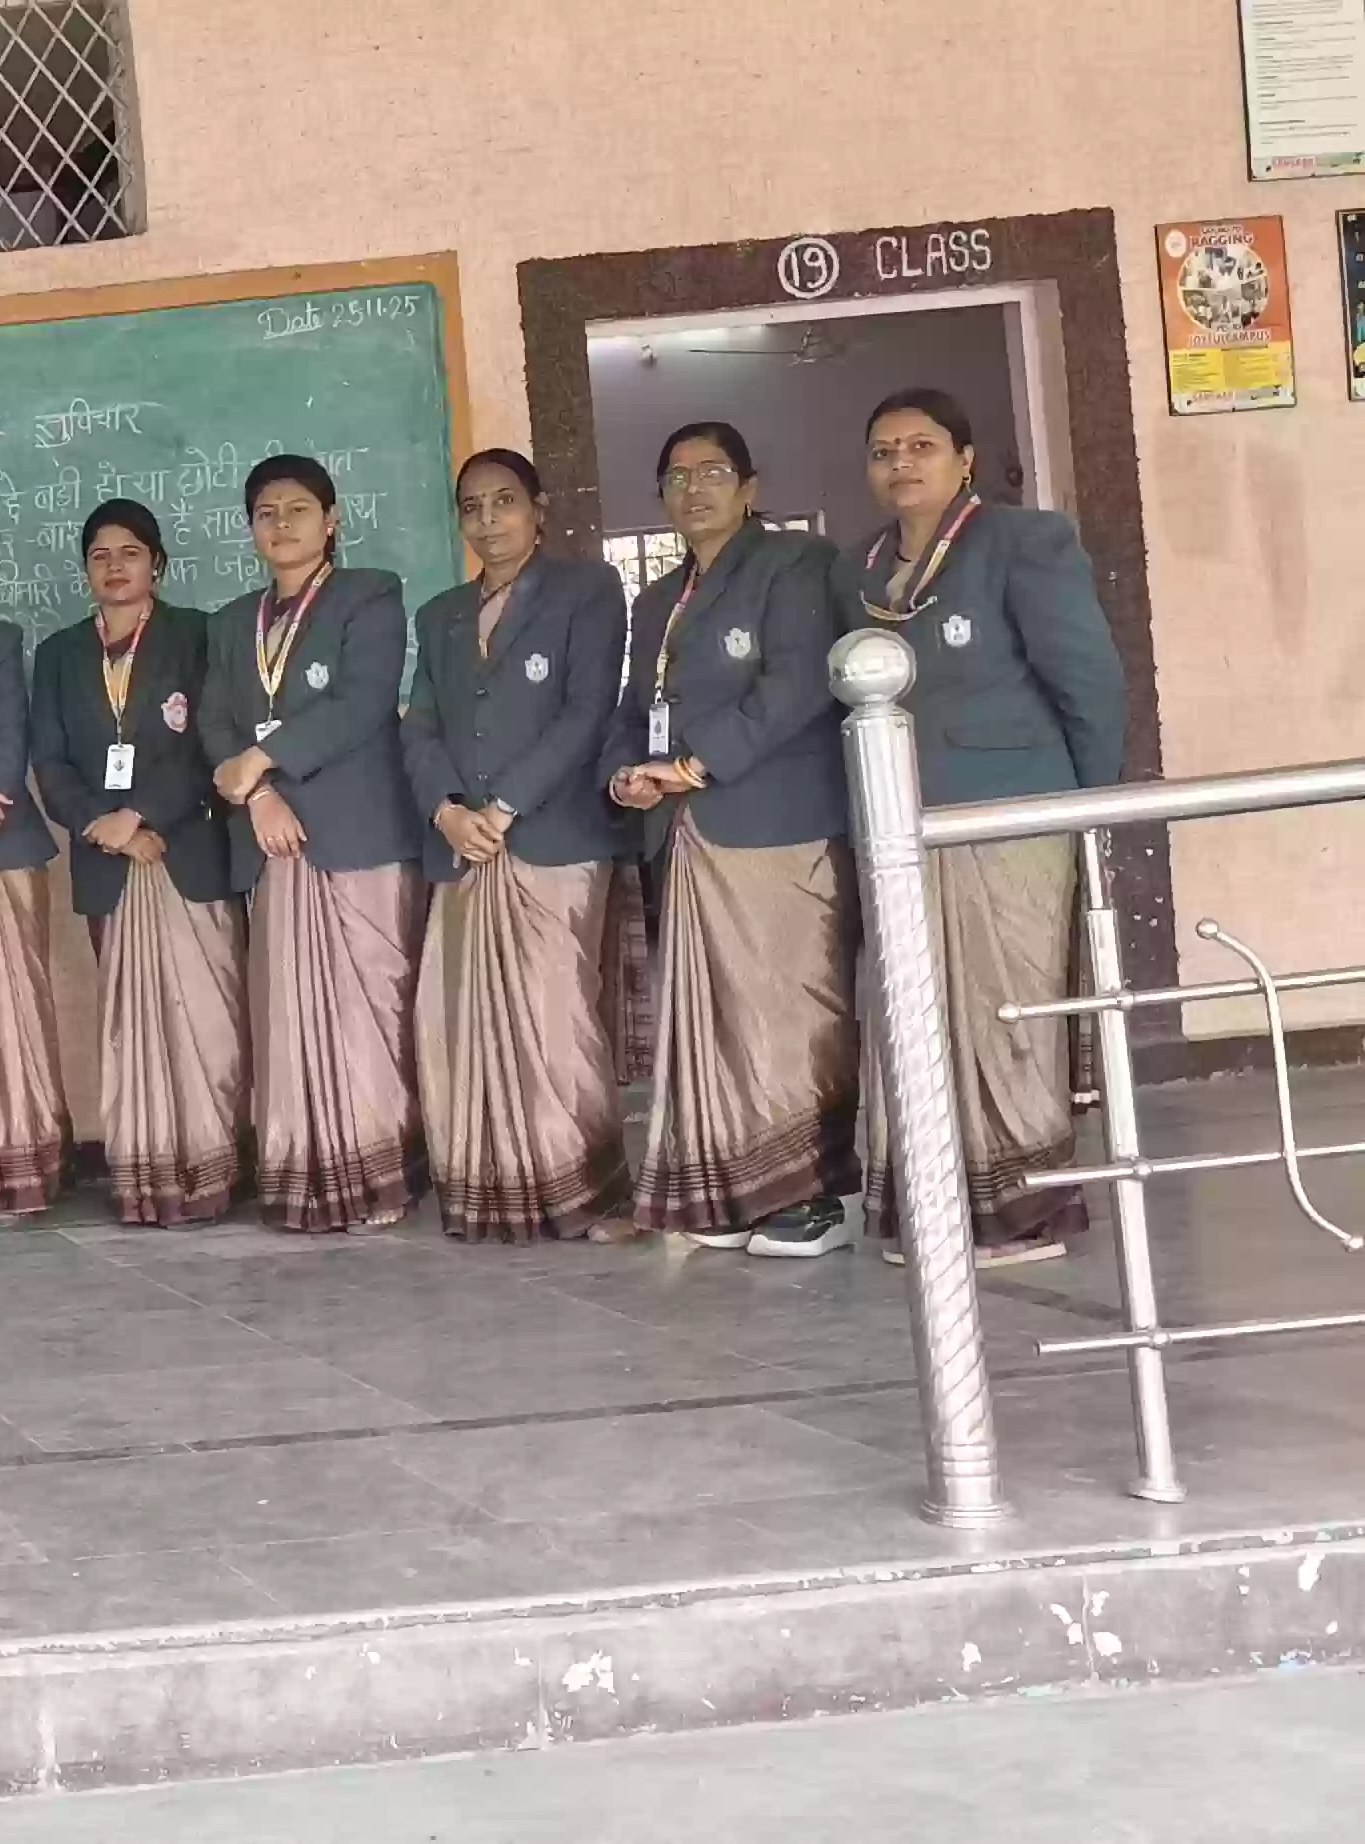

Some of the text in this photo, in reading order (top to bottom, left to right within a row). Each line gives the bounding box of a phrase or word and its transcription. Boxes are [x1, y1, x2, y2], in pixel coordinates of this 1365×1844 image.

[789, 229, 992, 289] 19 CLASS
[257, 301, 322, 340] Date
